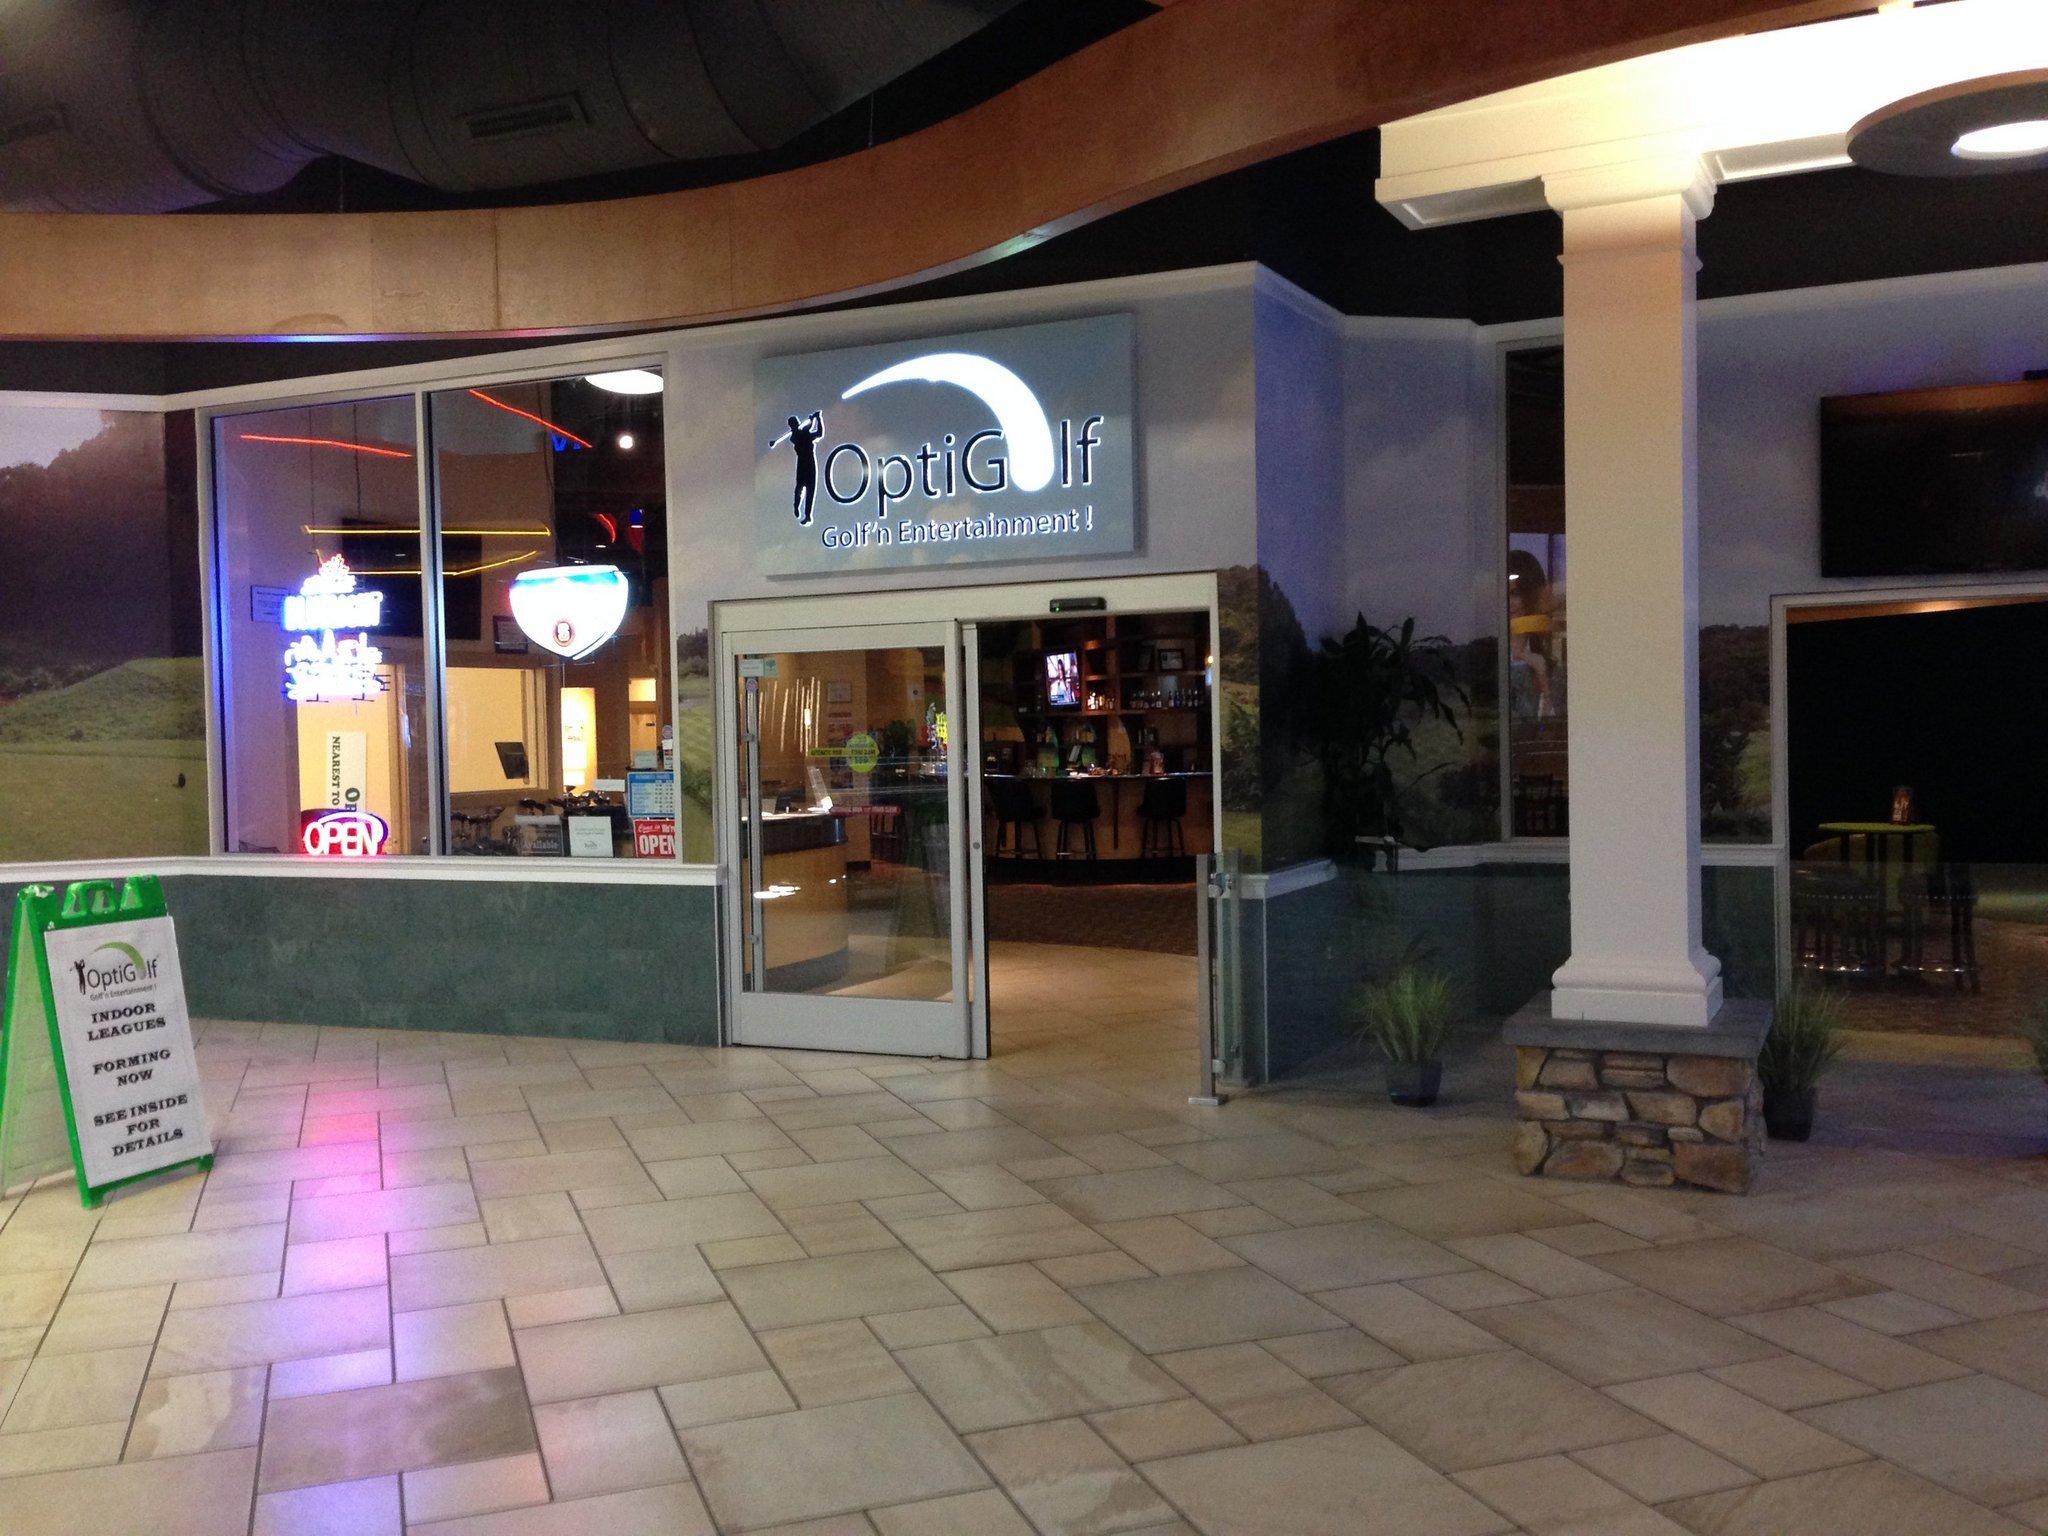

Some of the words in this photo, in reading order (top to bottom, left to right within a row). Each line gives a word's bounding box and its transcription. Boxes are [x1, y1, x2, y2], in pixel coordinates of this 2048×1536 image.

[331, 736, 341, 788] NEAREST
[331, 789, 341, 806] TO
[303, 820, 379, 857] OPEN
[91, 1002, 156, 1024] INDOOR
[87, 1017, 166, 1041] LEAGUES
[93, 1049, 171, 1075] FORMING
[116, 1069, 153, 1087] NOW
[93, 1109, 127, 1127] SEE
[130, 1094, 188, 1117] INSIDE
[127, 1118, 160, 1136] FOR
[112, 1127, 183, 1157] DETAILS
